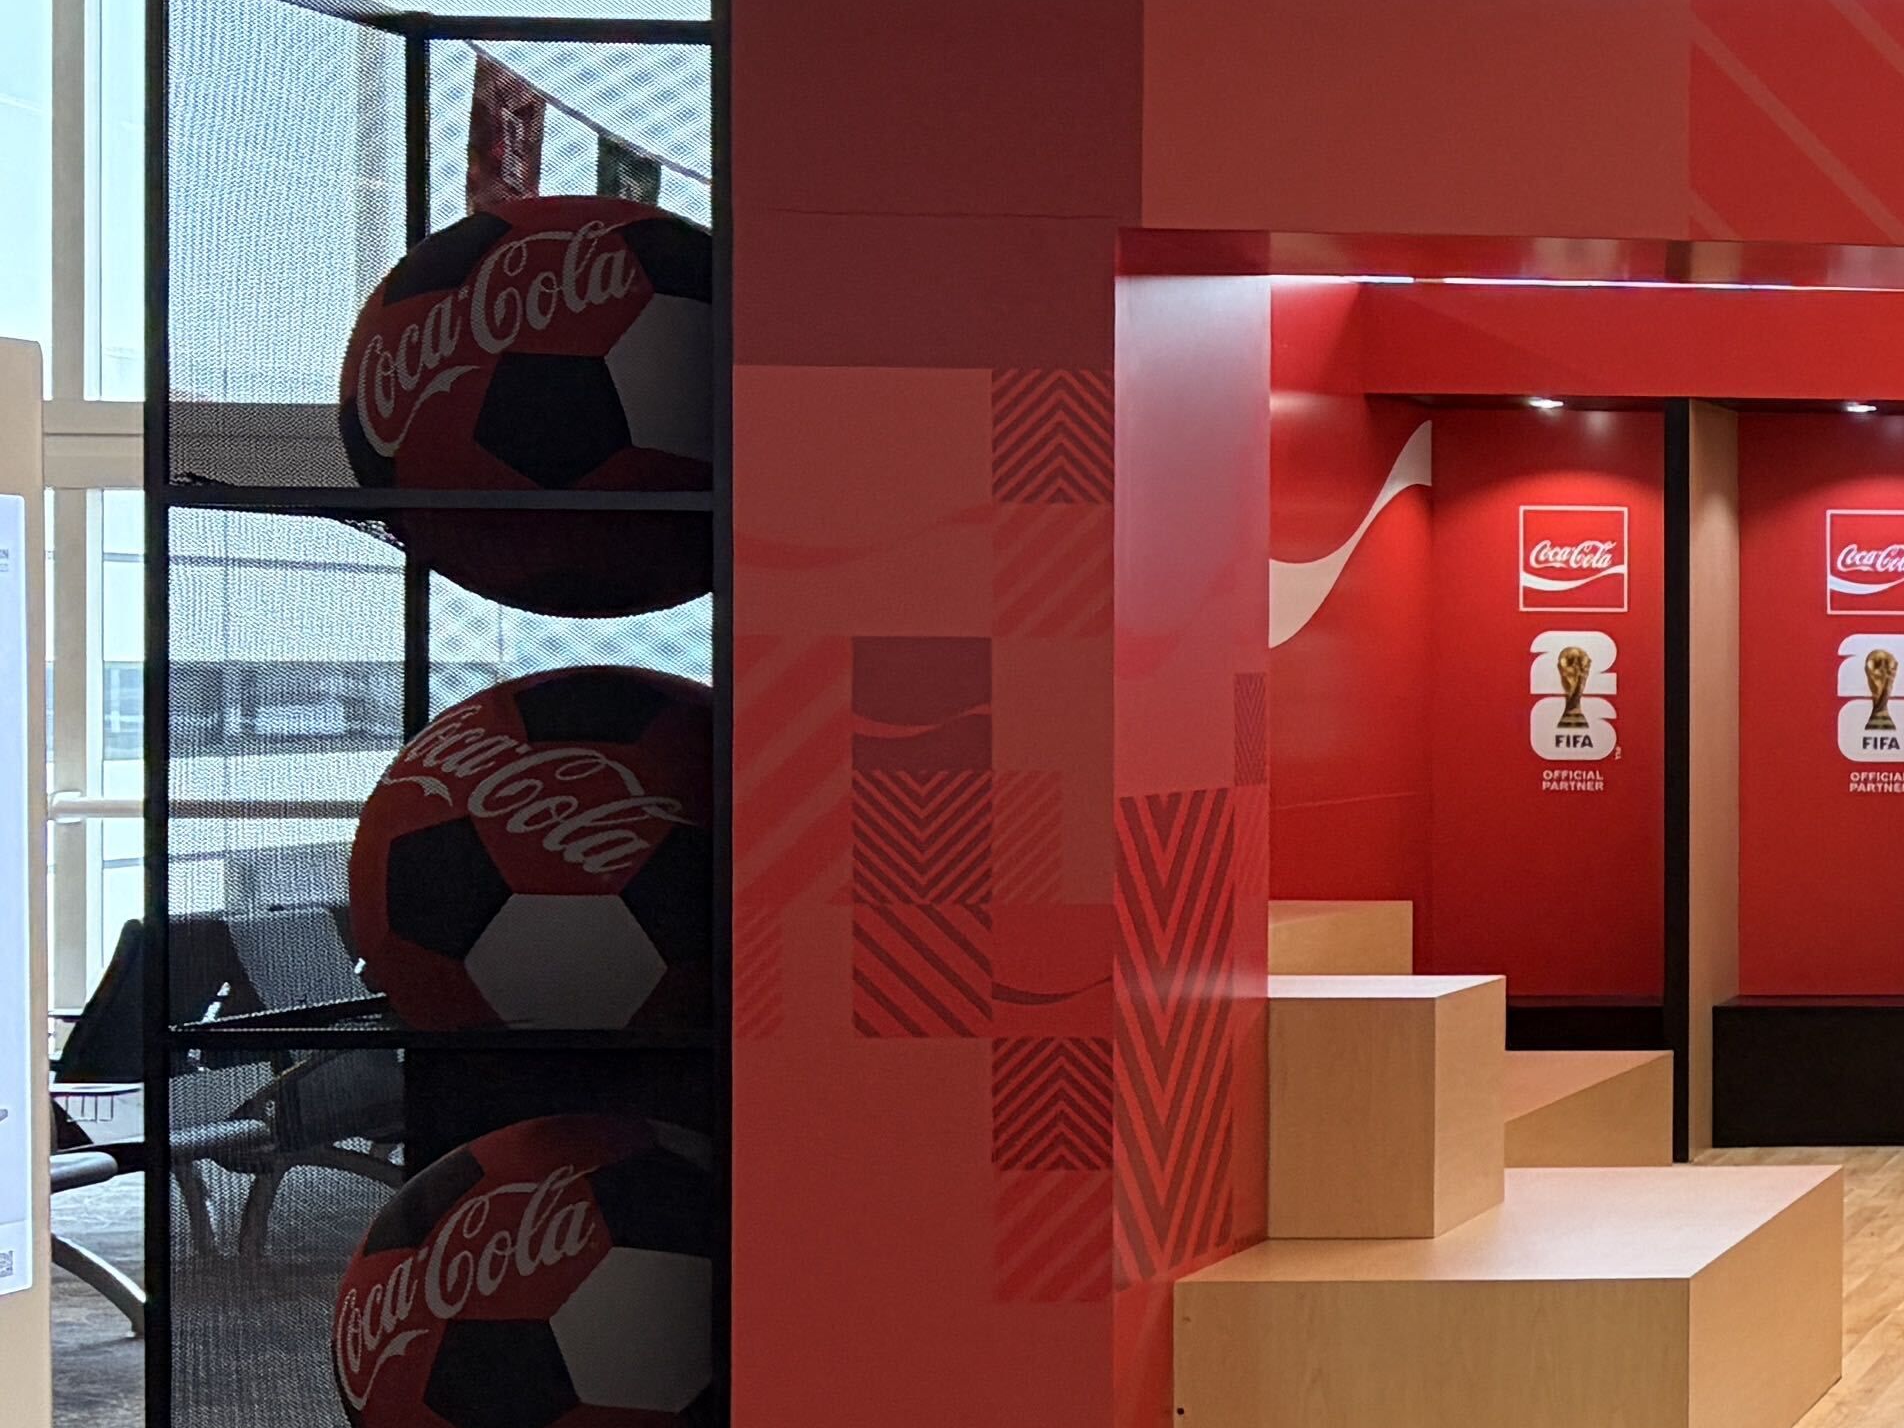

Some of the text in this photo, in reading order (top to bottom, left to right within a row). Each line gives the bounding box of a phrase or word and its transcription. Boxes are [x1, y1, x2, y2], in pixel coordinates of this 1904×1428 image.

[357, 220, 637, 457] Coca-Cola
[1529, 539, 1617, 569] Coca-Cola
[1555, 734, 1593, 749] FIFA
[1862, 736, 1900, 750] FIFA
[1542, 769, 1604, 781] OFFICIAL
[379, 704, 697, 874] Coca-Cola
[1542, 781, 1605, 792] PARTNER
[336, 1164, 600, 1412] Coca-Cola
